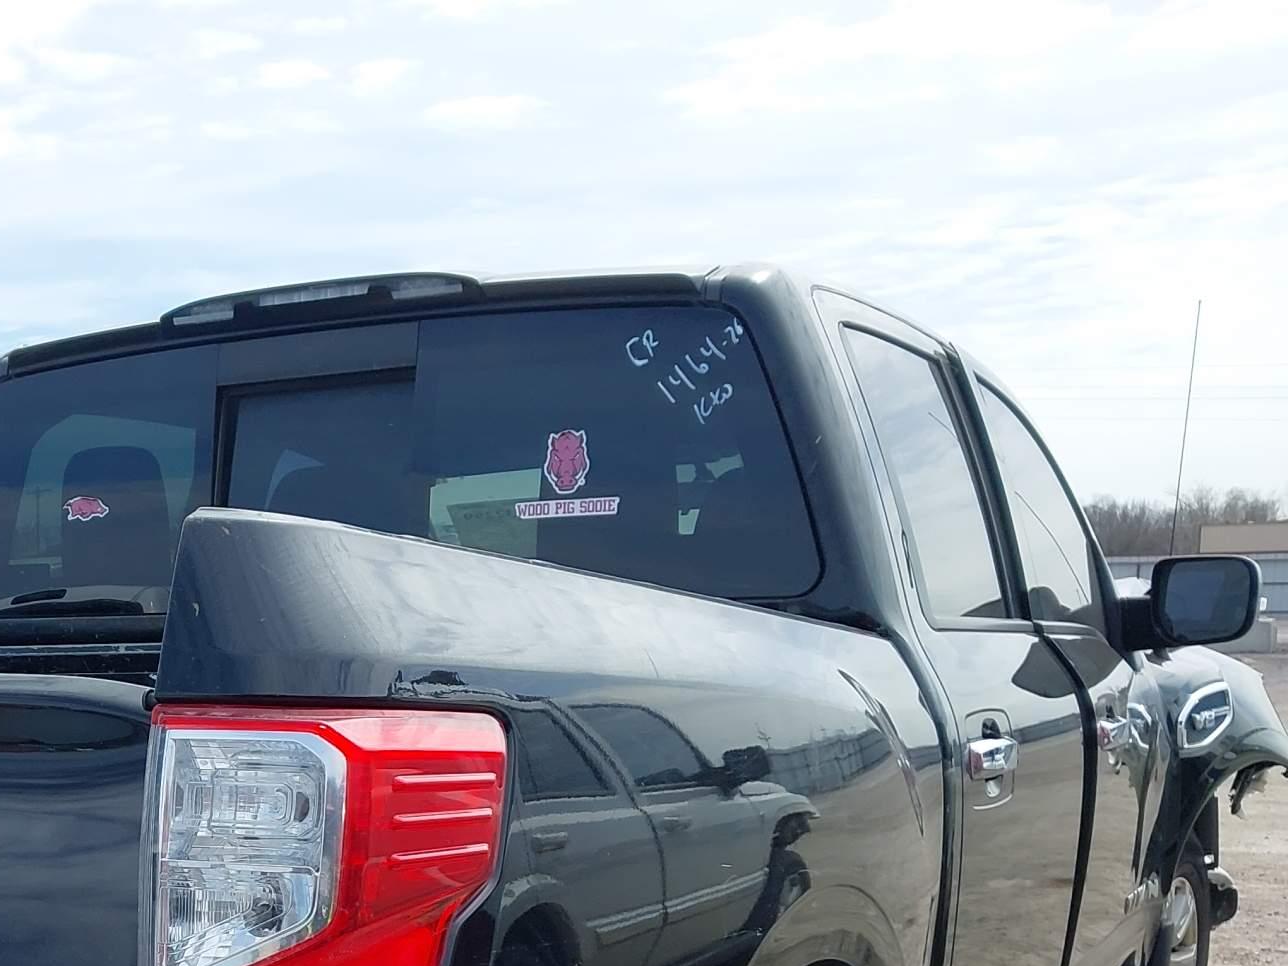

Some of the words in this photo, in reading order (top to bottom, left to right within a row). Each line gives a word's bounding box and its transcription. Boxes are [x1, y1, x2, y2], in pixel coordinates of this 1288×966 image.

[626, 329, 659, 366] CR
[554, 501, 575, 515] PIG
[579, 498, 616, 513] SOOIE
